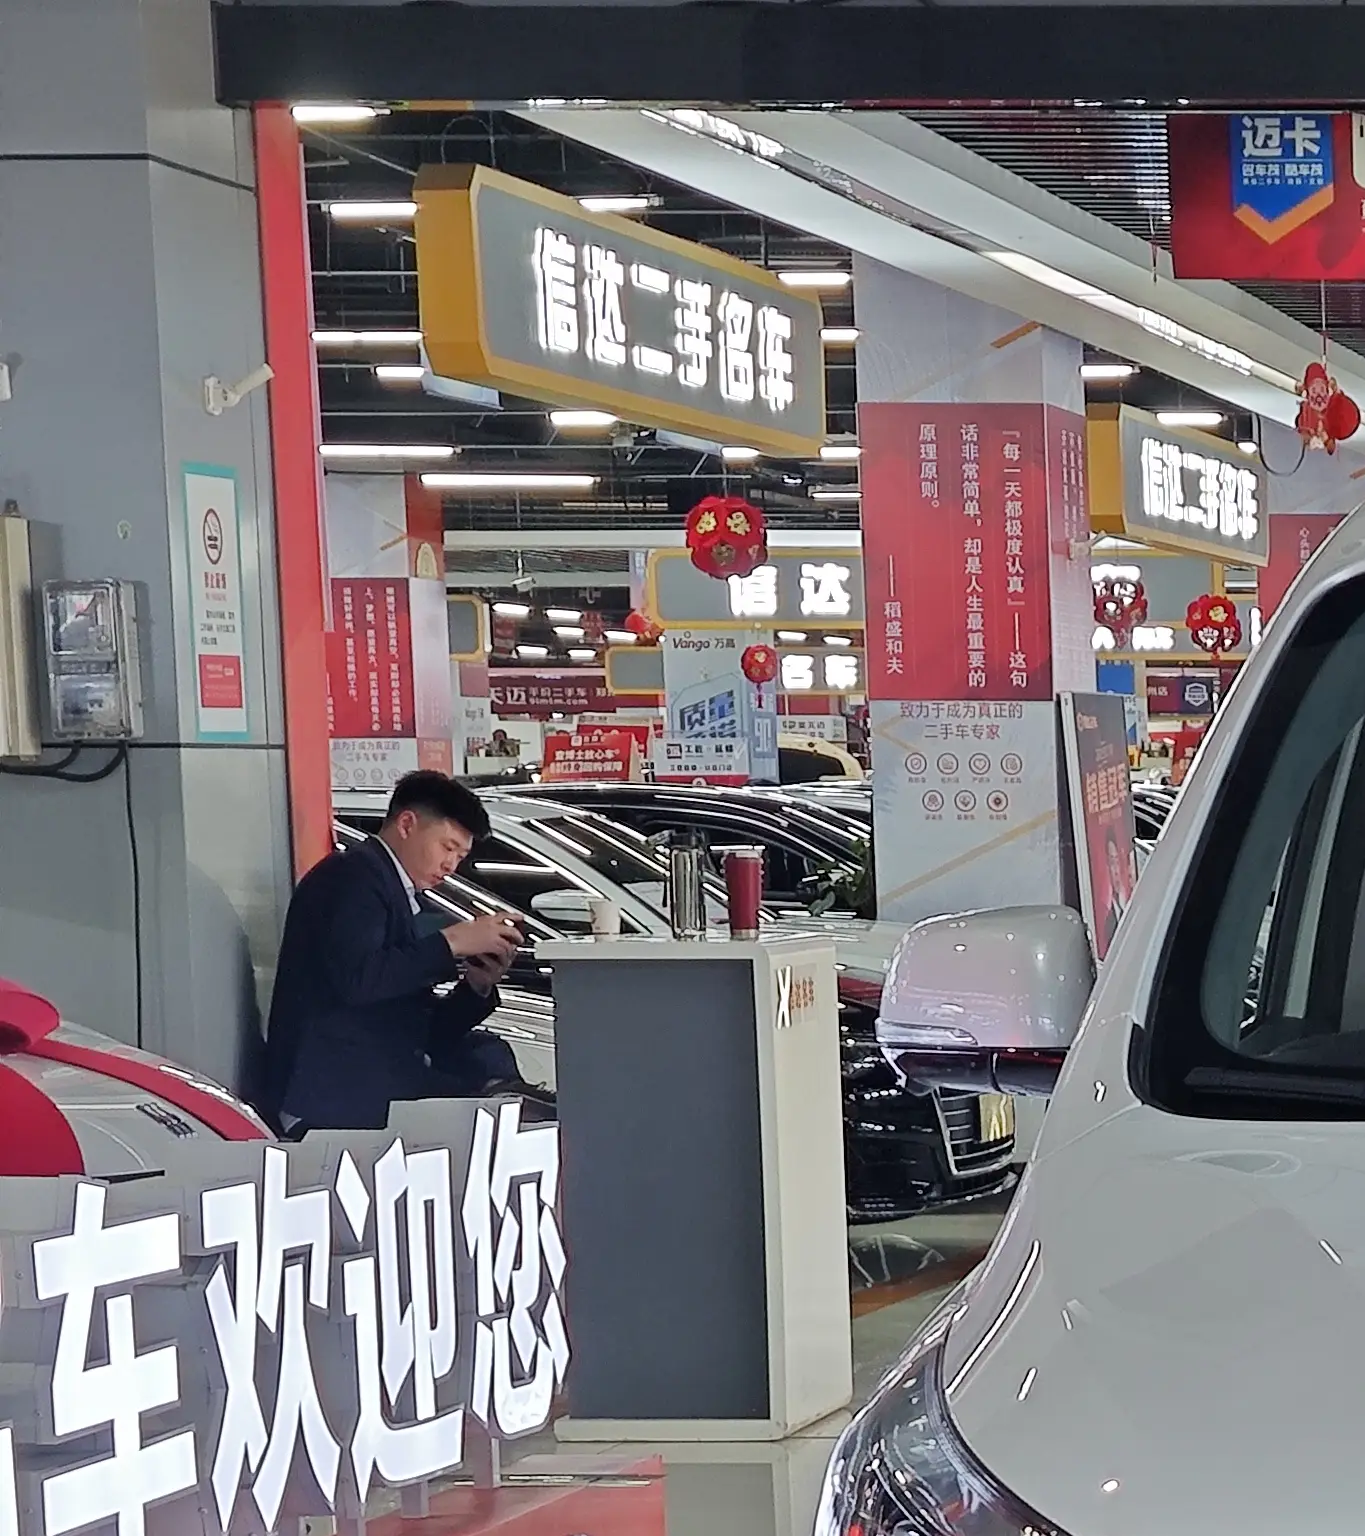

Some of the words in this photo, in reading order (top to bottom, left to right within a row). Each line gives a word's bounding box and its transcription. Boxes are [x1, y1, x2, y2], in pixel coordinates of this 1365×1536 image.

[1242, 116, 1321, 157] 迈卡
[533, 226, 795, 414] 信达二手名车
[900, 702, 1023, 719] 致力于成为真正的
[925, 724, 1001, 740] 二手车专家
